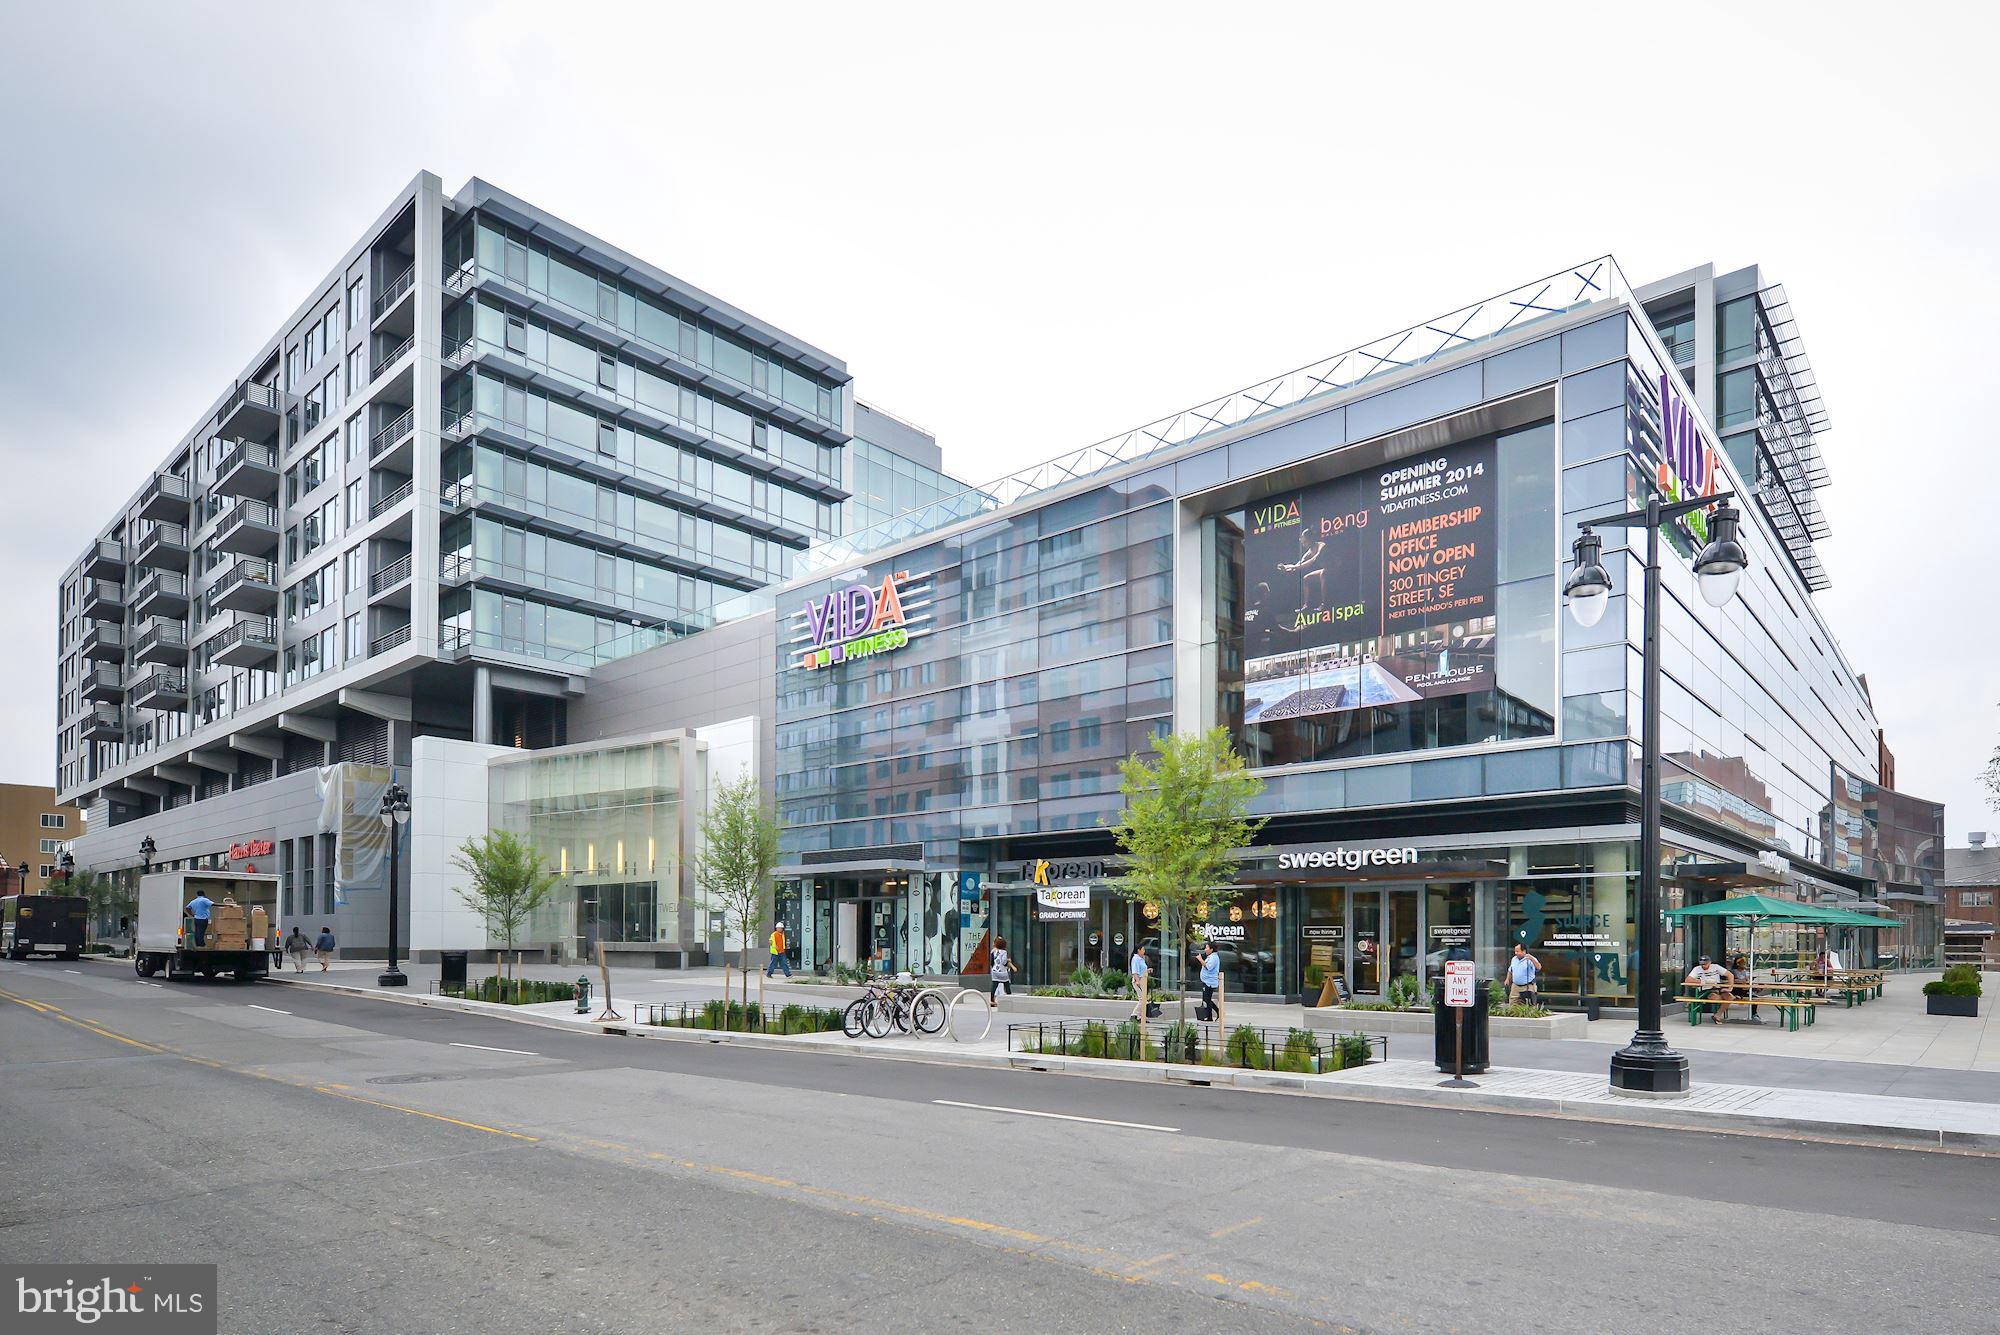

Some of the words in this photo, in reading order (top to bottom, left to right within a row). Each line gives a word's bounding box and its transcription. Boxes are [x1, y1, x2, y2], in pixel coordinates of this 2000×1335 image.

[1380, 457, 1447, 486] OPENING
[1381, 474, 1441, 501] SUMMER
[1446, 462, 1484, 484] 2014
[1381, 484, 1468, 515] VIDAFITNESS.COM
[1254, 501, 1299, 526] VIDA
[1274, 517, 1300, 529] FITNESS
[1321, 510, 1368, 534] bang
[1389, 506, 1481, 541] MEMBERSHIP
[1389, 534, 1438, 557] OFFICE
[1389, 553, 1429, 574] NOW
[1433, 543, 1475, 565] OPEN
[1389, 577, 1413, 593] 300
[1417, 565, 1466, 587] TINGEY
[1389, 588, 1434, 608] STREET,
[1439, 583, 1454, 598] SE
[804, 574, 906, 648] VIDA
[1388, 610, 1405, 620] NEXT
[1418, 601, 1453, 613] NANDO'S
[1454, 598, 1468, 607] PERI
[1469, 596, 1484, 604] PERI
[844, 628, 908, 660] FITNESS
[1405, 664, 1484, 683] PENTHOUSE
[1447, 676, 1472, 684] LOUNGE
[1278, 847, 1418, 871] sweetgreen
[1039, 911, 1060, 919] GRAND
[1555, 914, 1610, 928] SOURCE
[969, 932, 982, 940] THE
[1320, 928, 1337, 936] hiring
[1452, 977, 1467, 985] ANY
[1452, 988, 1468, 996] TIME
